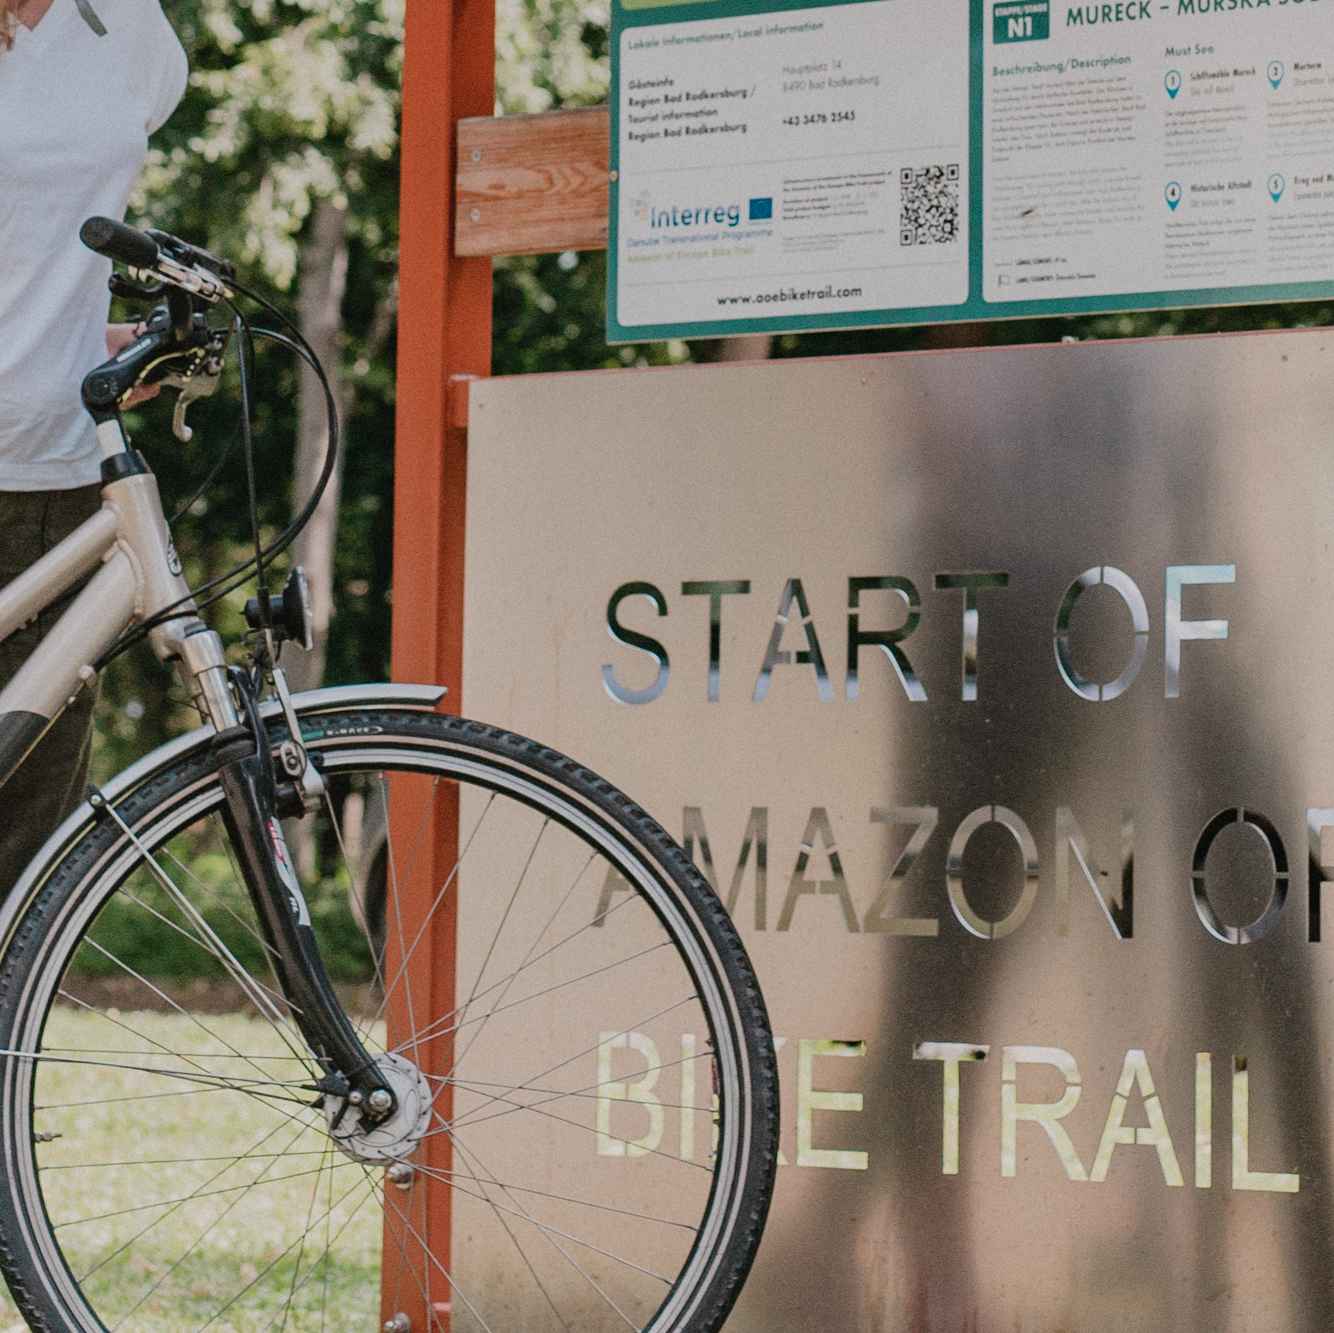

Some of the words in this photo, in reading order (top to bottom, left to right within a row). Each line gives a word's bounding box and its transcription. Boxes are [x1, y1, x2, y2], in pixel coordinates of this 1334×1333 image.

[1066, 0, 1152, 26] MURECK
[1008, 16, 1032, 39] N1
[1165, 46, 1191, 57] Must
[1195, 43, 1215, 54] See
[664, 92, 682, 103] Bad
[686, 87, 747, 101] Radkersburg
[664, 126, 682, 137] Bad
[686, 122, 747, 135] Radkersburg
[1171, 187, 1176, 197] 4
[651, 202, 741, 229] Interreg
[717, 285, 863, 306] www.aoebiketrail.com
[601, 572, 1009, 705] START
[1053, 565, 1236, 702] OF
[912, 1039, 1301, 1193] TRAIL
